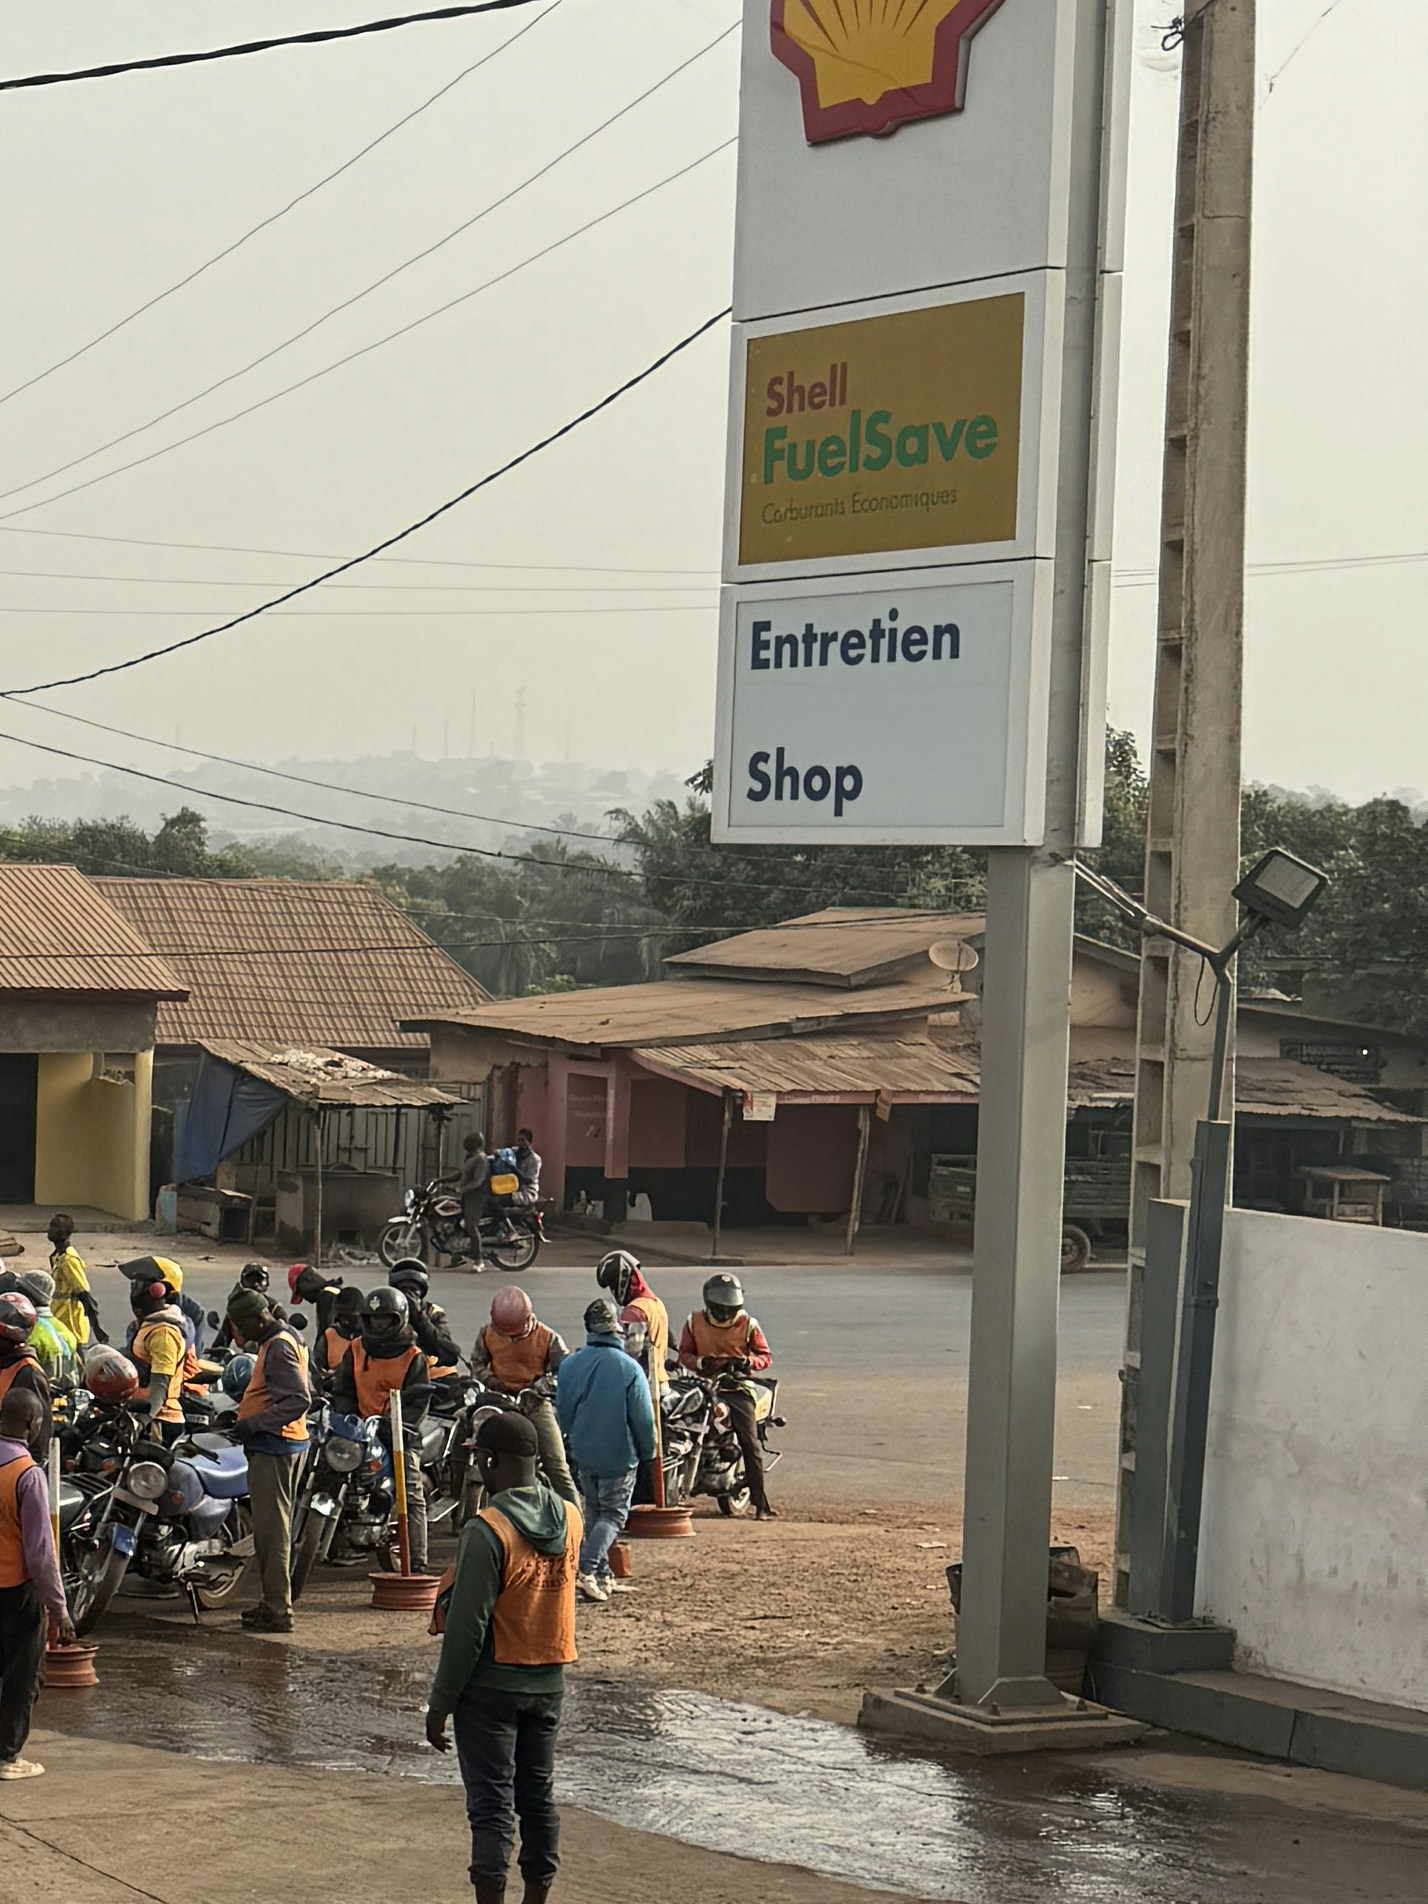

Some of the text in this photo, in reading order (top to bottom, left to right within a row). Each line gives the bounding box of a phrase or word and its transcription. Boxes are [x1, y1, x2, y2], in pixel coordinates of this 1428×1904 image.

[766, 361, 848, 417] Shell
[764, 409, 998, 485] FuelSave
[762, 486, 958, 524] Carburants Économiques
[751, 607, 961, 670] Entretien
[746, 747, 863, 817] Shop
